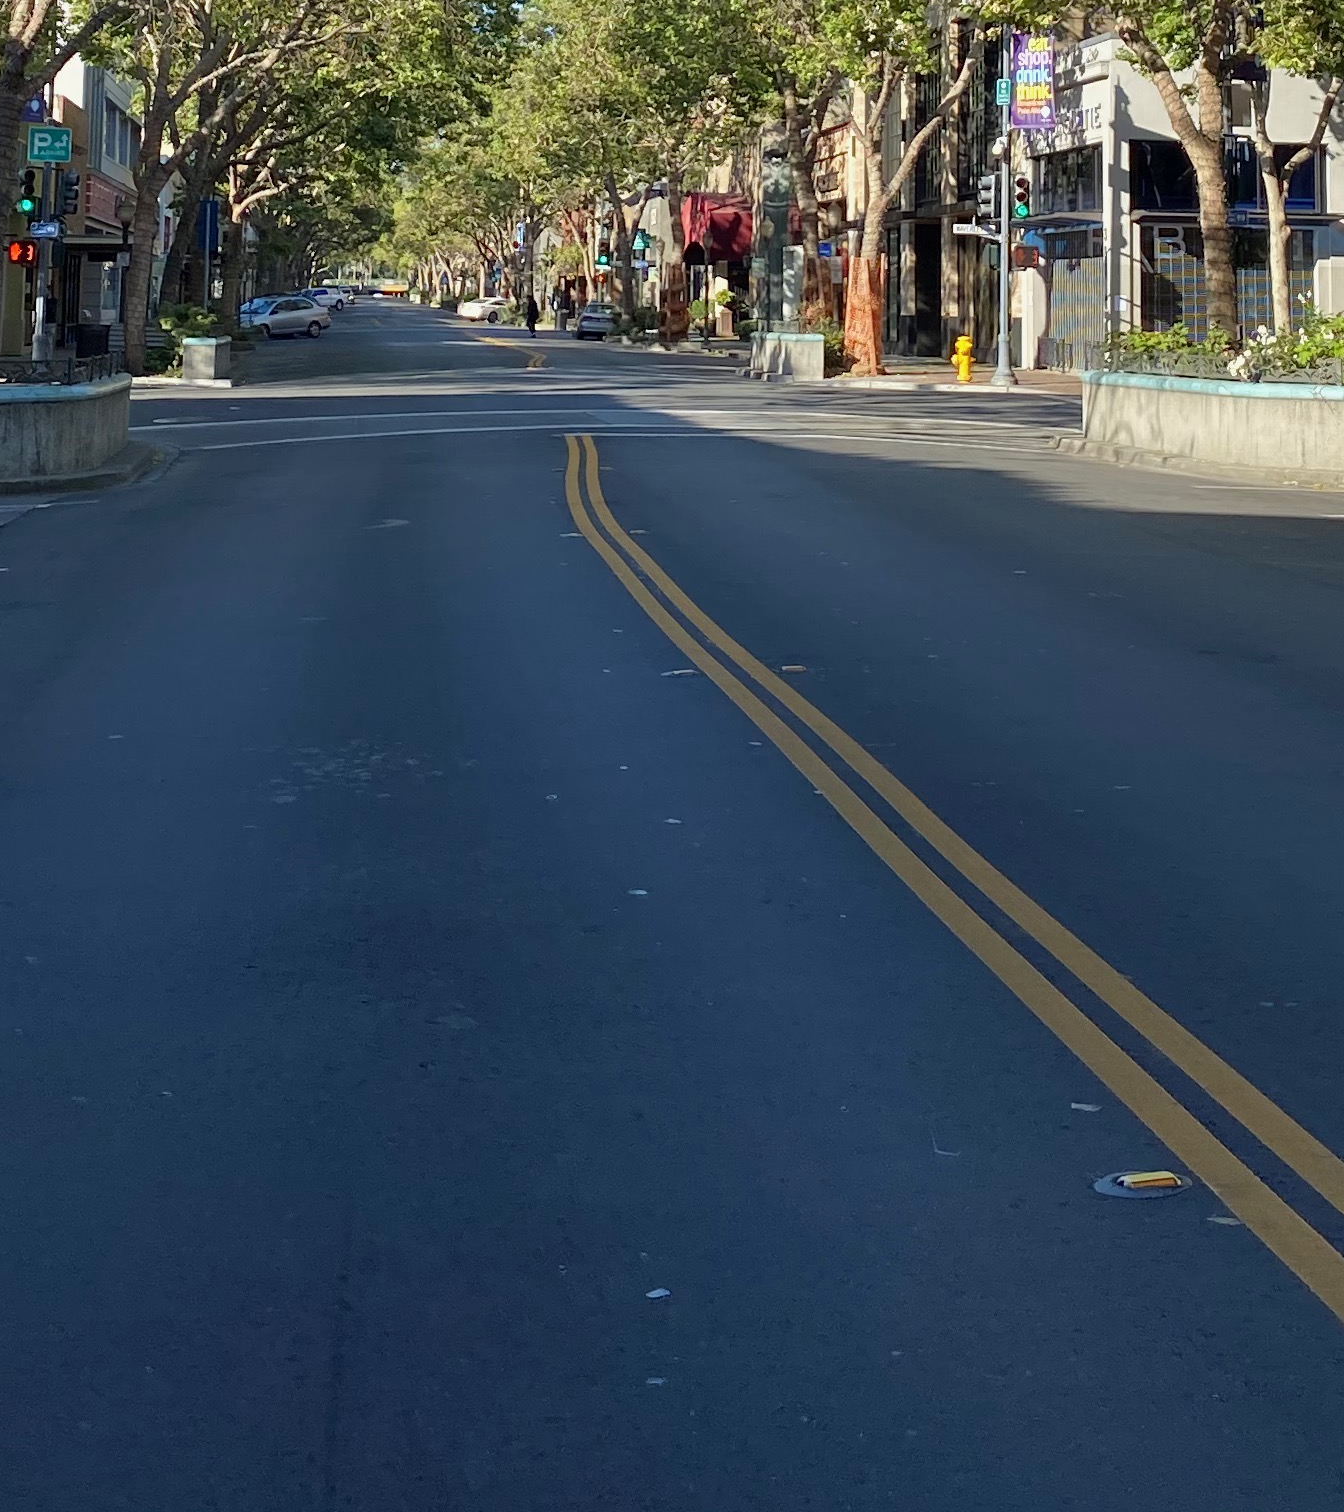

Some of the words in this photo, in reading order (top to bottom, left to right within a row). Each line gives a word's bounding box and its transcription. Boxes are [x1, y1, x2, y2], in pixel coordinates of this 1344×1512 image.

[1018, 49, 1052, 69] shop.
[1016, 66, 1052, 84] drink.
[1016, 83, 1053, 101] think.
